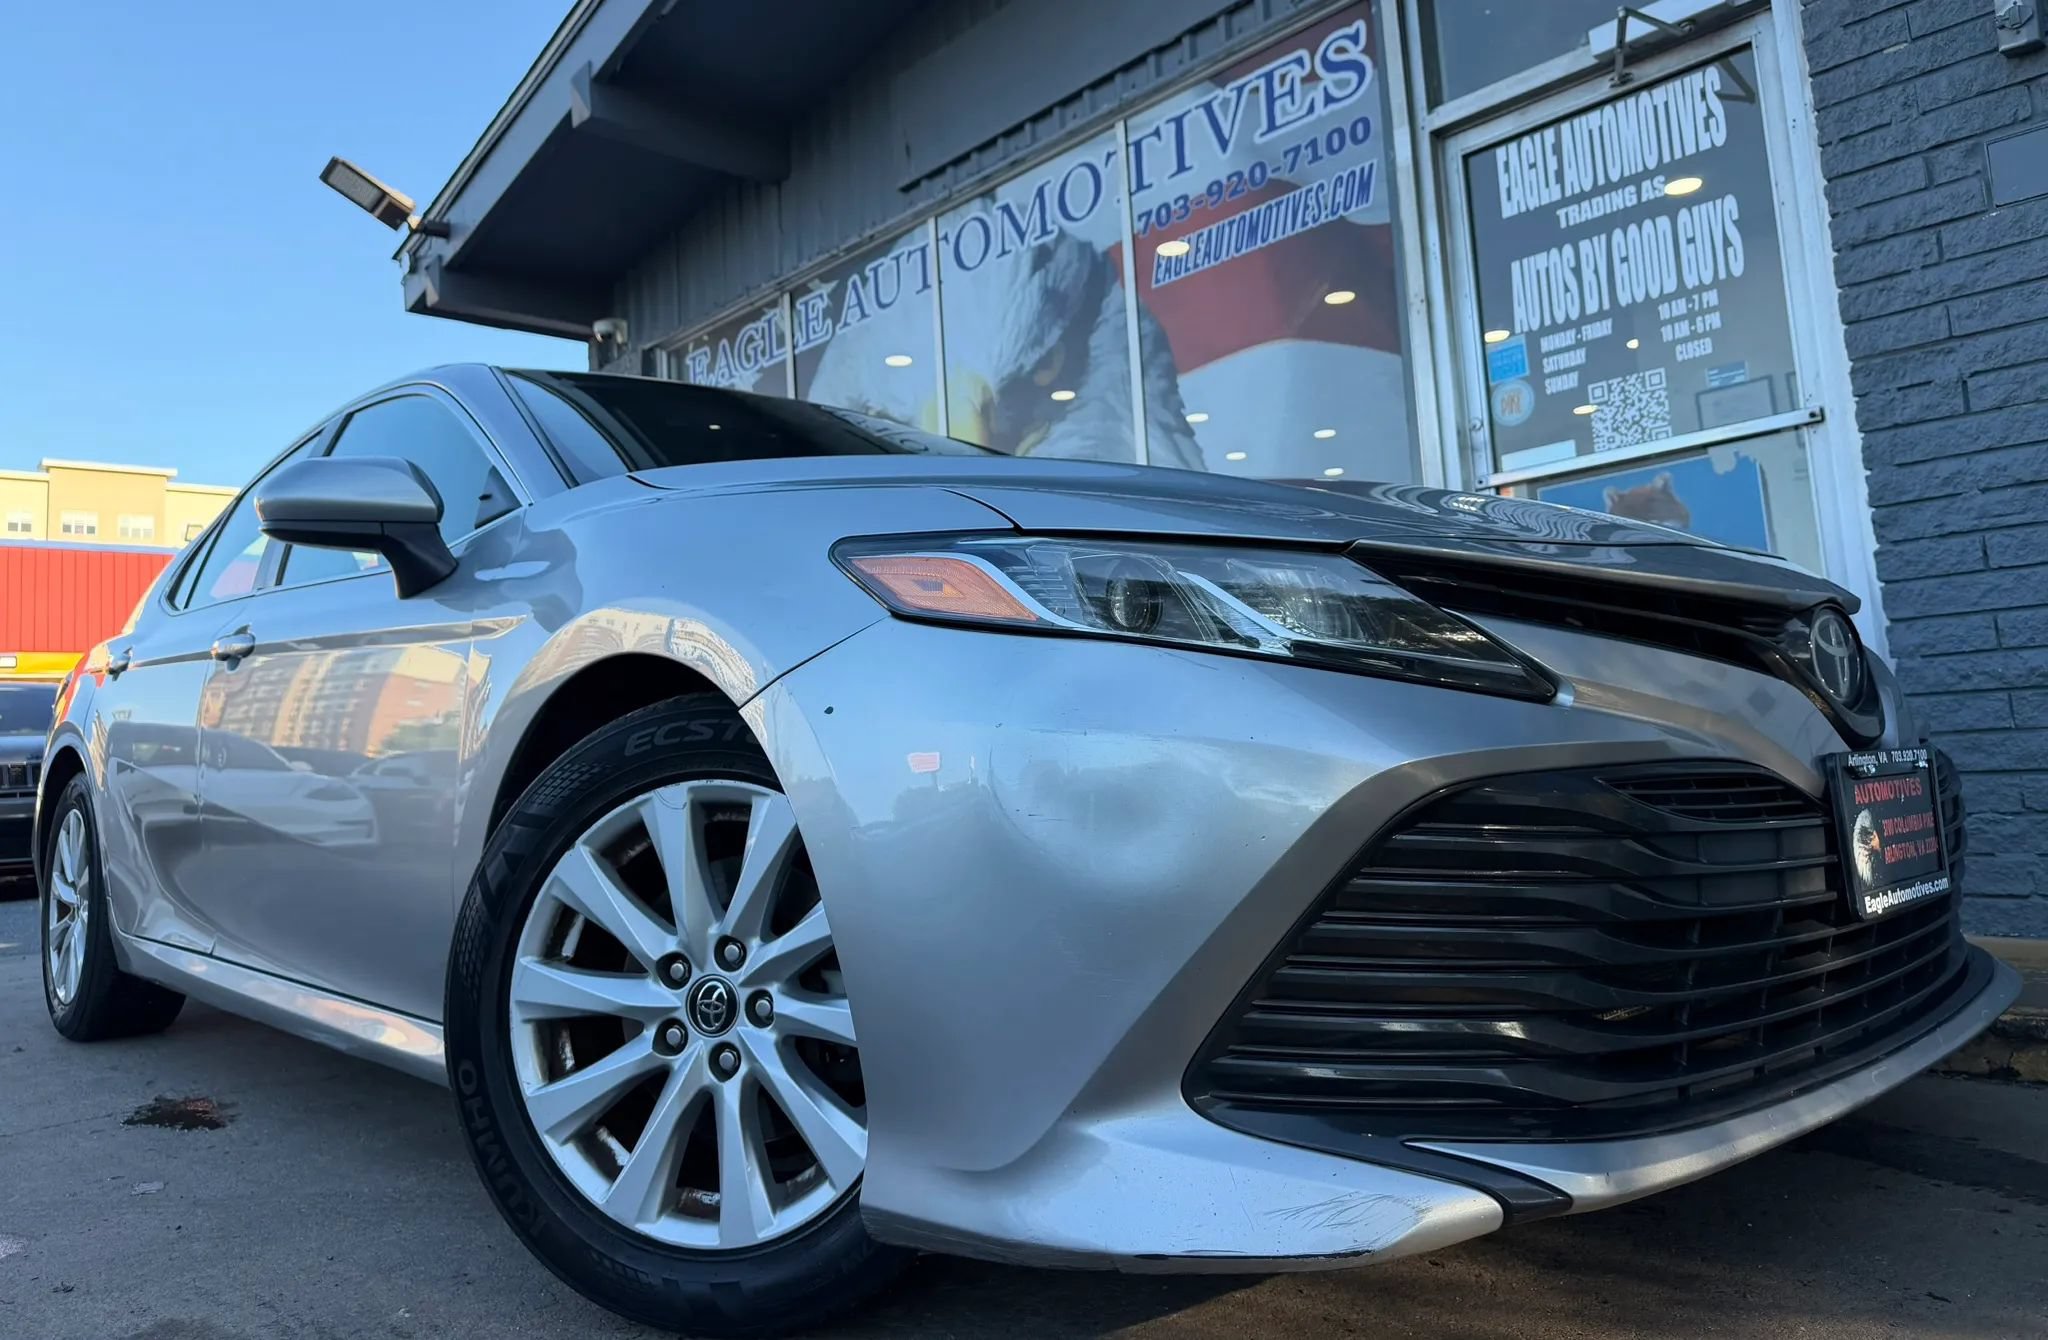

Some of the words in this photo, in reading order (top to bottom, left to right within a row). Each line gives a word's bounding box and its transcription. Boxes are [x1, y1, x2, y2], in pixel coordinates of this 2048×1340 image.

[1497, 128, 1561, 219] EAGLE
[1559, 65, 1727, 197] AUTOMOTIVES
[1137, 116, 1371, 235] 703-920-7100
[687, 290, 832, 386] EAGLE
[837, 21, 1372, 333] AUTOMOTIVES
[1556, 188, 1638, 228] TRADING
[1640, 175, 1666, 203] AS
[1153, 161, 1376, 286] EAGLEAUTOMOTIVES.COM
[1511, 242, 1580, 335] AUTOS
[1578, 233, 1610, 315] BY
[1611, 214, 1679, 308] GOOD
[1676, 194, 1744, 289] GUYS
[1670, 298, 1687, 318] AM
[1702, 289, 1719, 309] PM
[1540, 328, 1576, 353] MONDAY
[1581, 318, 1613, 342] FRIDAY
[1672, 320, 1690, 339] AM
[1704, 311, 1722, 331] PM
[1542, 347, 1586, 374] SATURDAY
[1675, 337, 1713, 362] CLOSED
[1545, 371, 1579, 395] SUNDAY
[1878, 751, 1888, 764] VA
[1855, 778, 1922, 805] AUTOMOTIVES
[1864, 877, 1949, 914] EagleAutomotives.com
[458, 1059, 547, 1237] KUMHO
